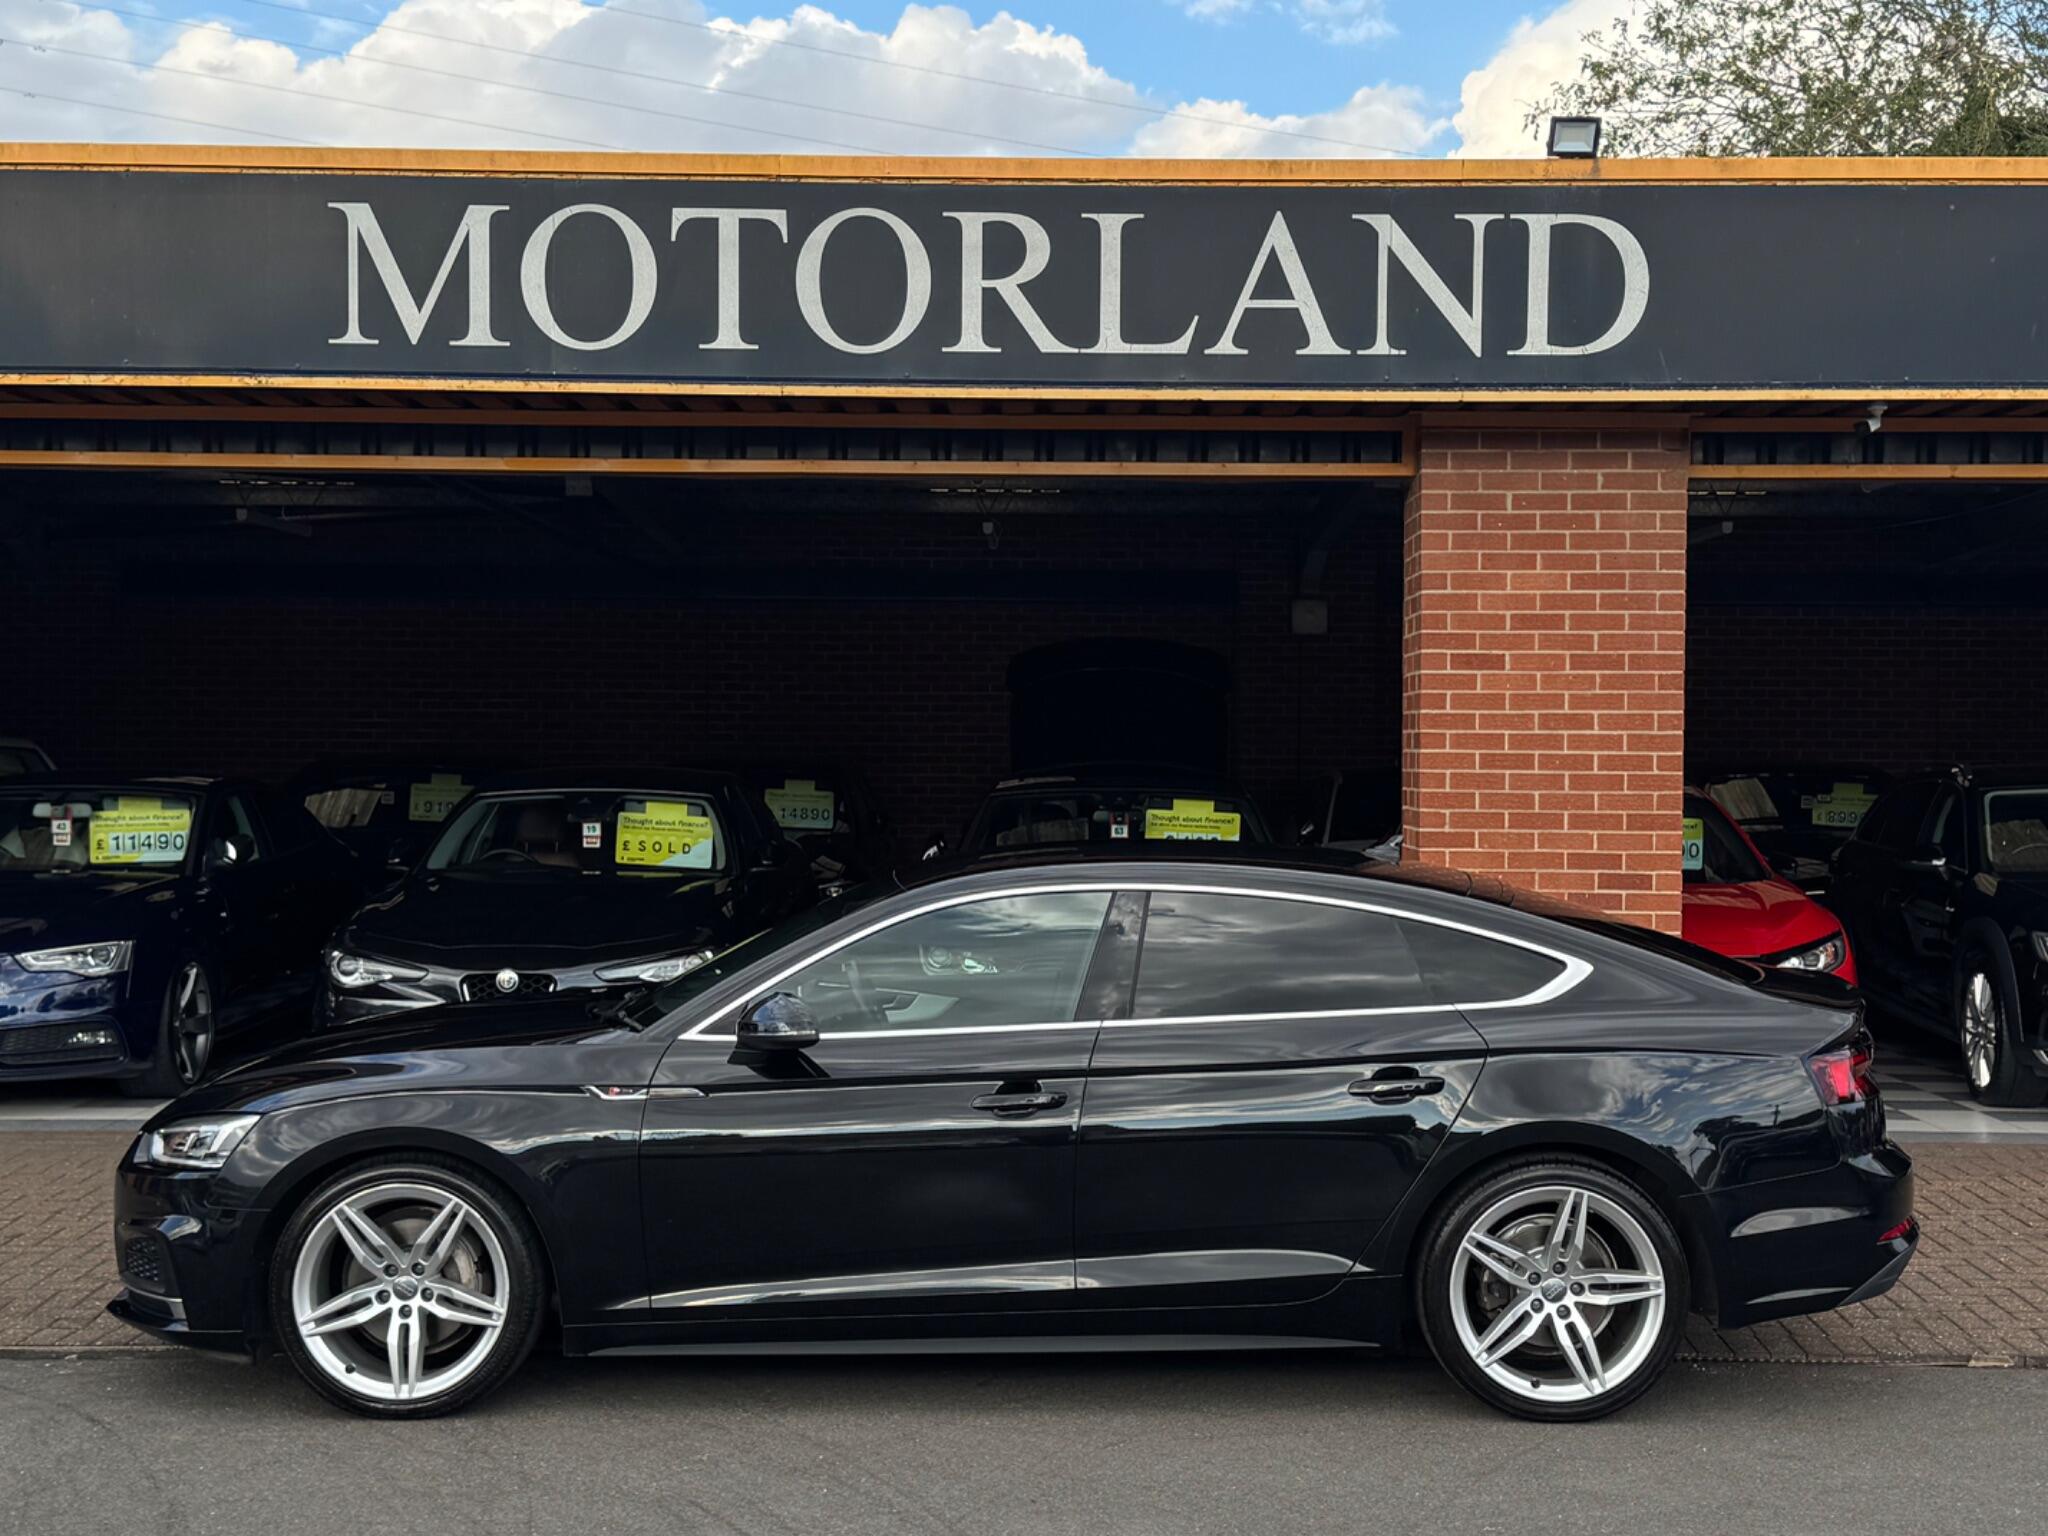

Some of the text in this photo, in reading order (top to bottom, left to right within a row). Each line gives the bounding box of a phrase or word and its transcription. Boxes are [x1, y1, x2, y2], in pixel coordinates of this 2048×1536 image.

[327, 202, 1650, 357] MOTORLAND
[624, 815, 653, 827] Thought
[655, 818, 676, 827] about
[780, 807, 831, 821] 14890
[1150, 813, 1180, 824] Thought
[1182, 815, 1202, 824] about
[111, 833, 185, 851] 11490
[638, 840, 692, 855] SOLD
